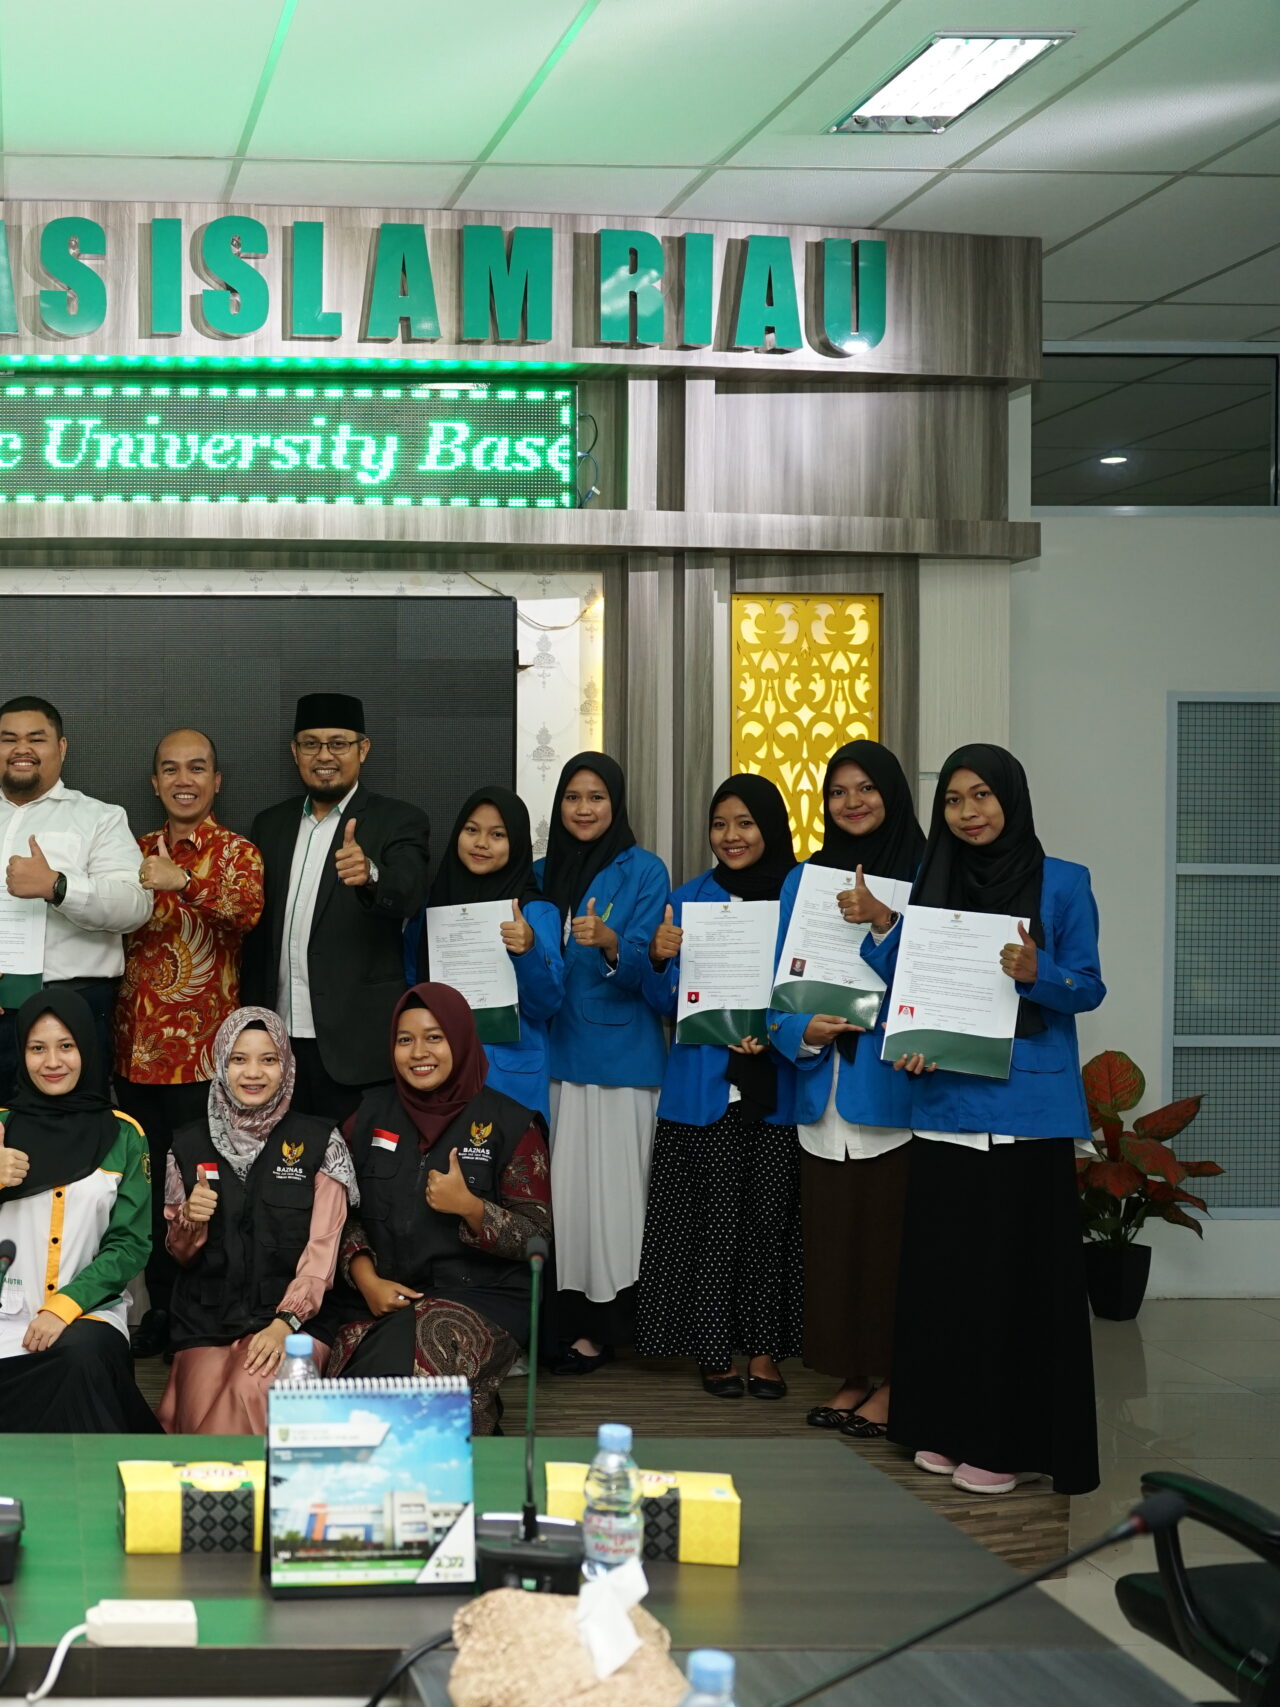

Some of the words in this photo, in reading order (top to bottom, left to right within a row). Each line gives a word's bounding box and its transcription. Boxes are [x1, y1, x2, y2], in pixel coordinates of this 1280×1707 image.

[150, 214, 553, 346] ISLAM
[599, 228, 888, 357] RIAU
[43, 414, 399, 485] University
[276, 1166, 303, 1174] BAZNAS
[463, 1147, 490, 1155] BAZNAS
